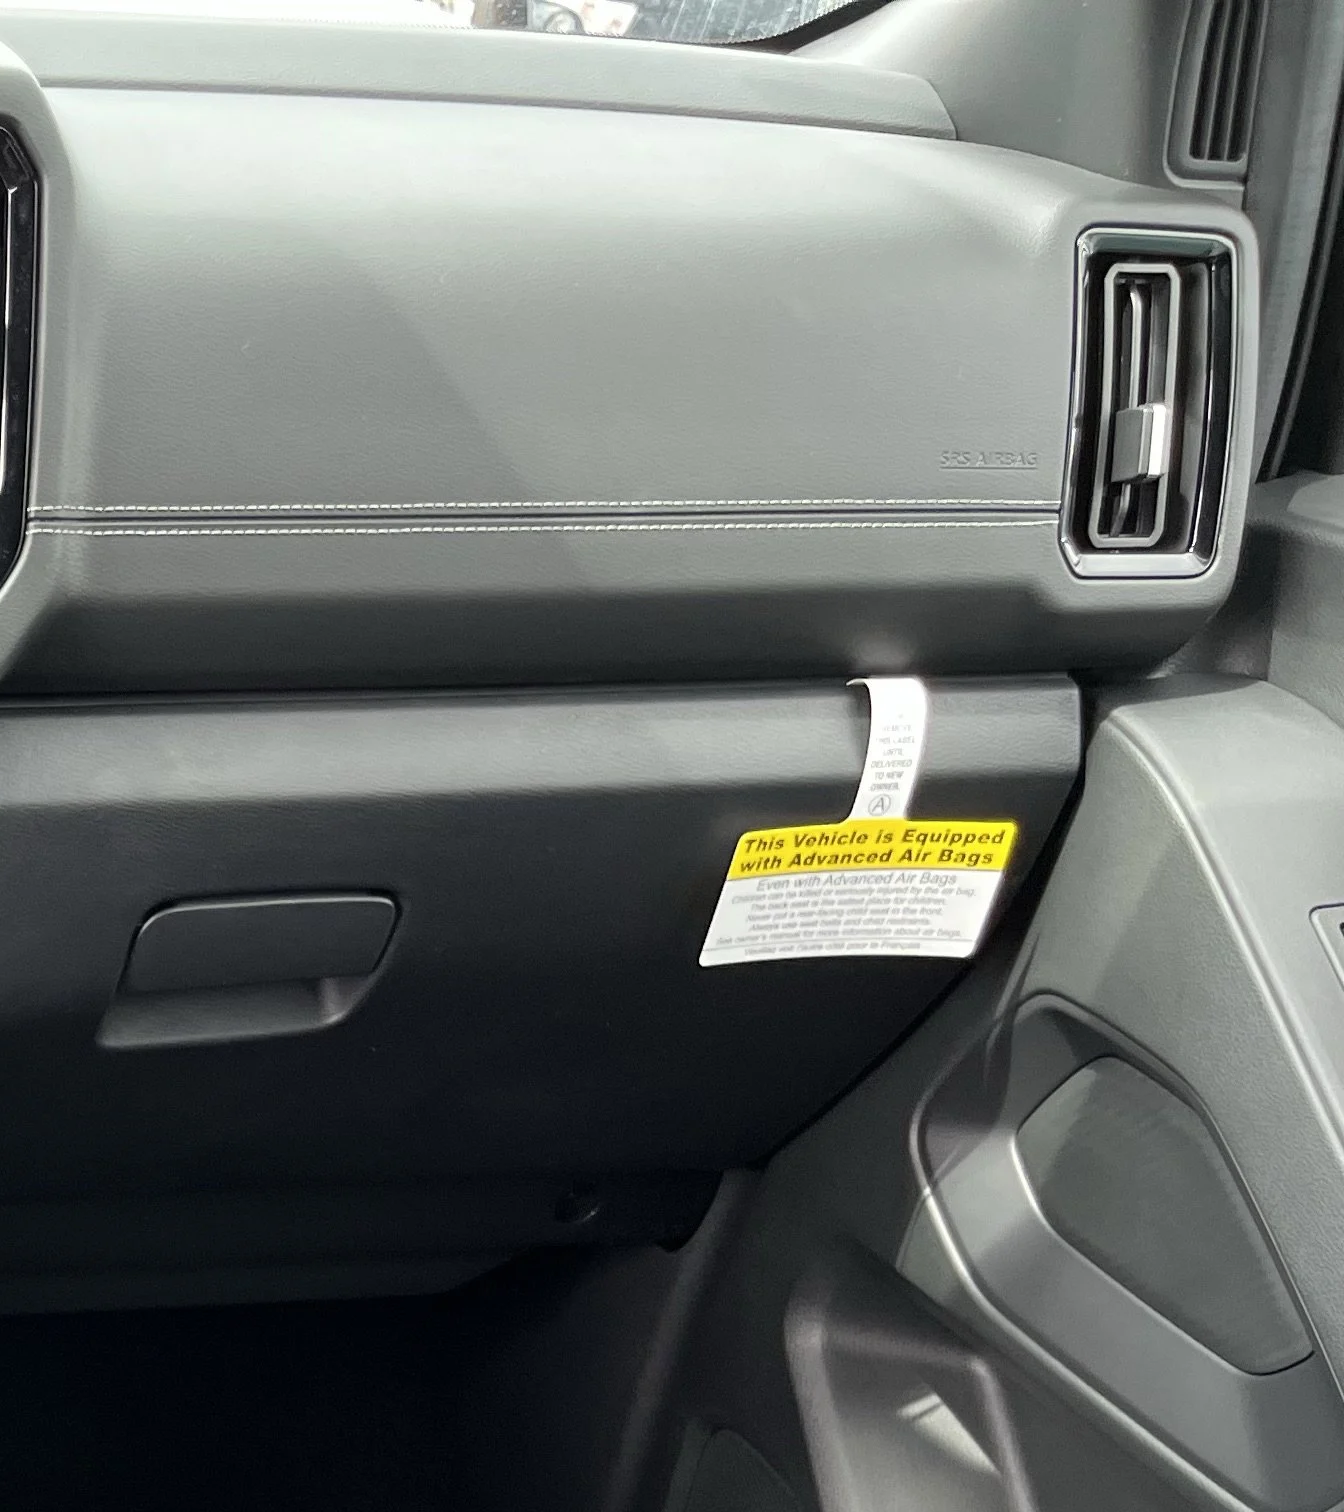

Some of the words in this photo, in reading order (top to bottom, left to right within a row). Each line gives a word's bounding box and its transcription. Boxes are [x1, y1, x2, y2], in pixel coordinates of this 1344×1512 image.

[744, 837, 785, 854] This
[793, 831, 869, 848] Vehicle
[876, 830, 893, 844] is
[902, 828, 1006, 848] Equipped
[740, 855, 782, 873] with
[788, 849, 893, 868] Advanced
[898, 848, 932, 863] Air
[938, 849, 994, 867] Bags
[756, 878, 790, 892] Even
[793, 875, 822, 888] with
[823, 872, 894, 887] Advanced
[895, 872, 917, 884] Air
[919, 872, 957, 887] Bags
